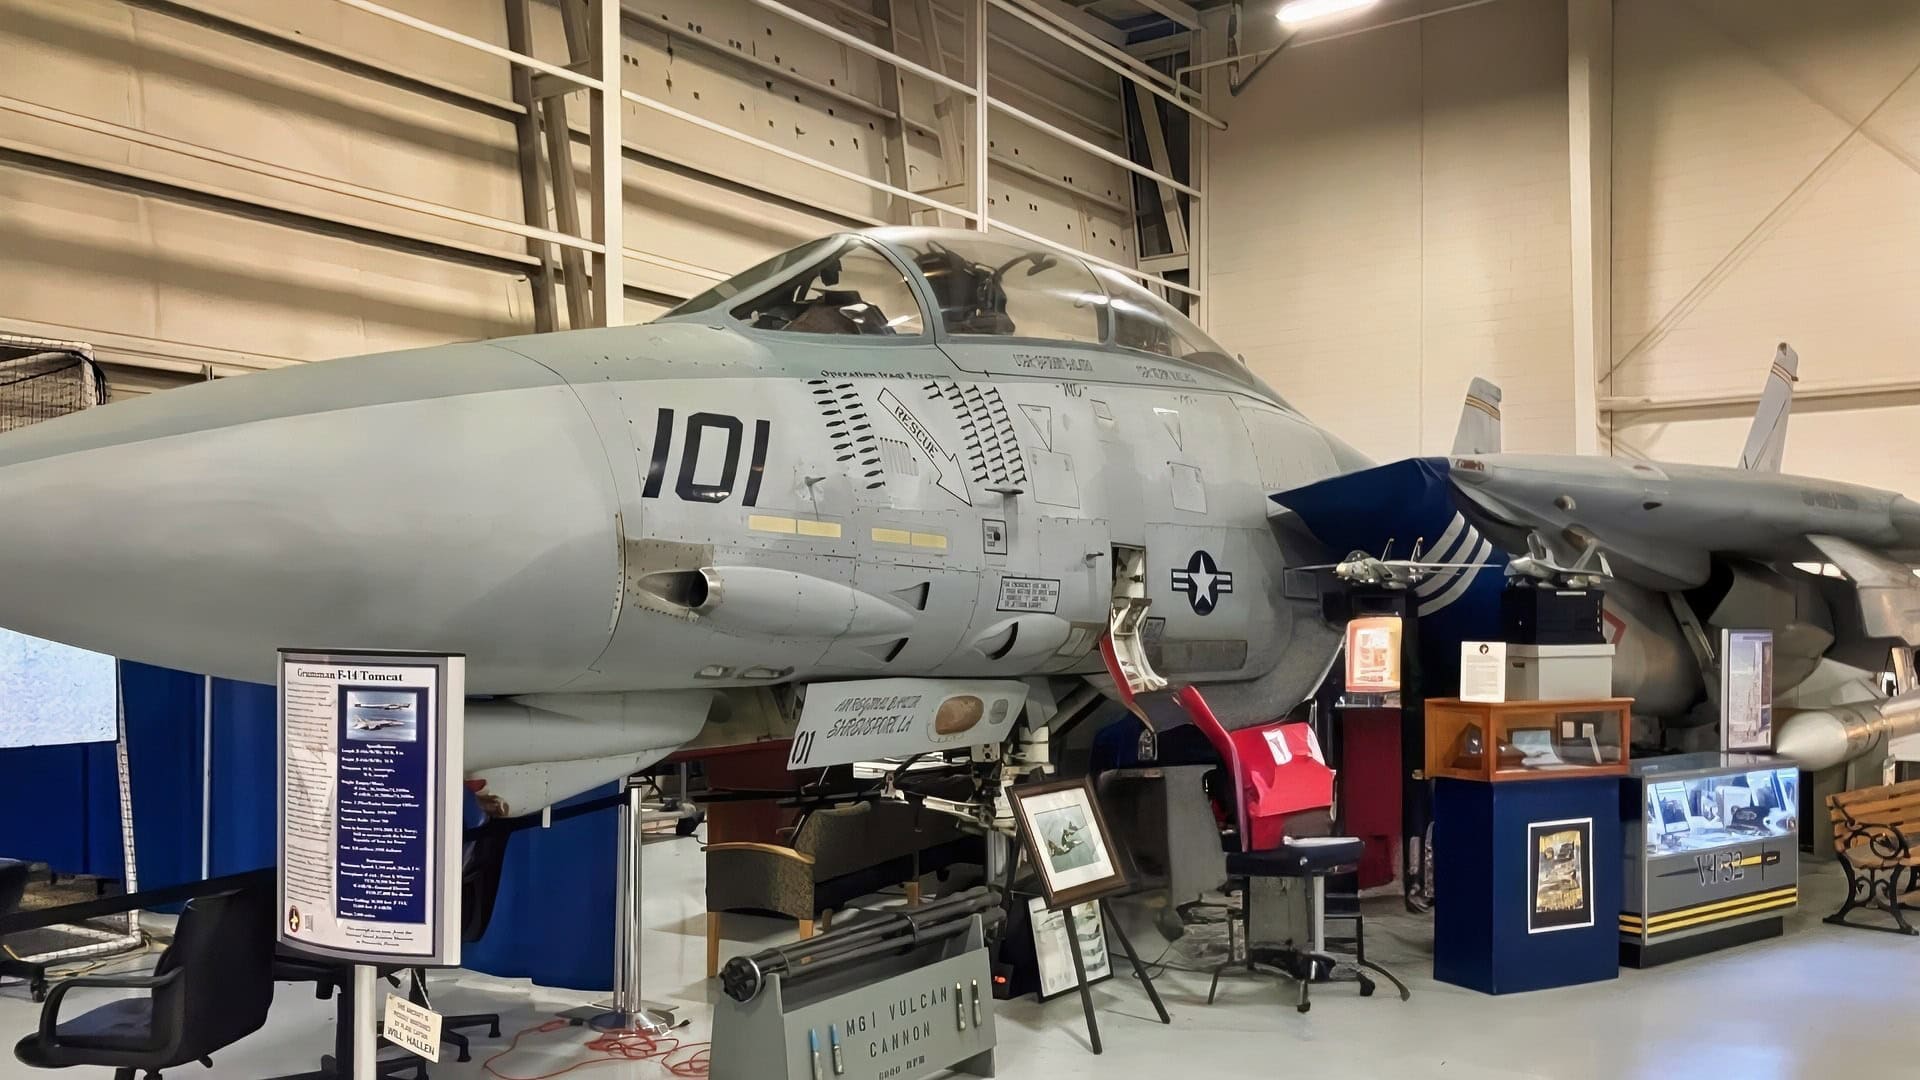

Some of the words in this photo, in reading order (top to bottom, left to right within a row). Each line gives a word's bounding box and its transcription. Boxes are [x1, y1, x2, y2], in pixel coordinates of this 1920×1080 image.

[894, 405, 939, 459] RESCUE
[641, 407, 771, 507] 101
[297, 667, 336, 679] Grumman
[337, 669, 358, 680] F-14
[360, 670, 403, 681] Tomcat
[888, 986, 947, 1021] VULCAN
[869, 1020, 931, 1058] CANNON
